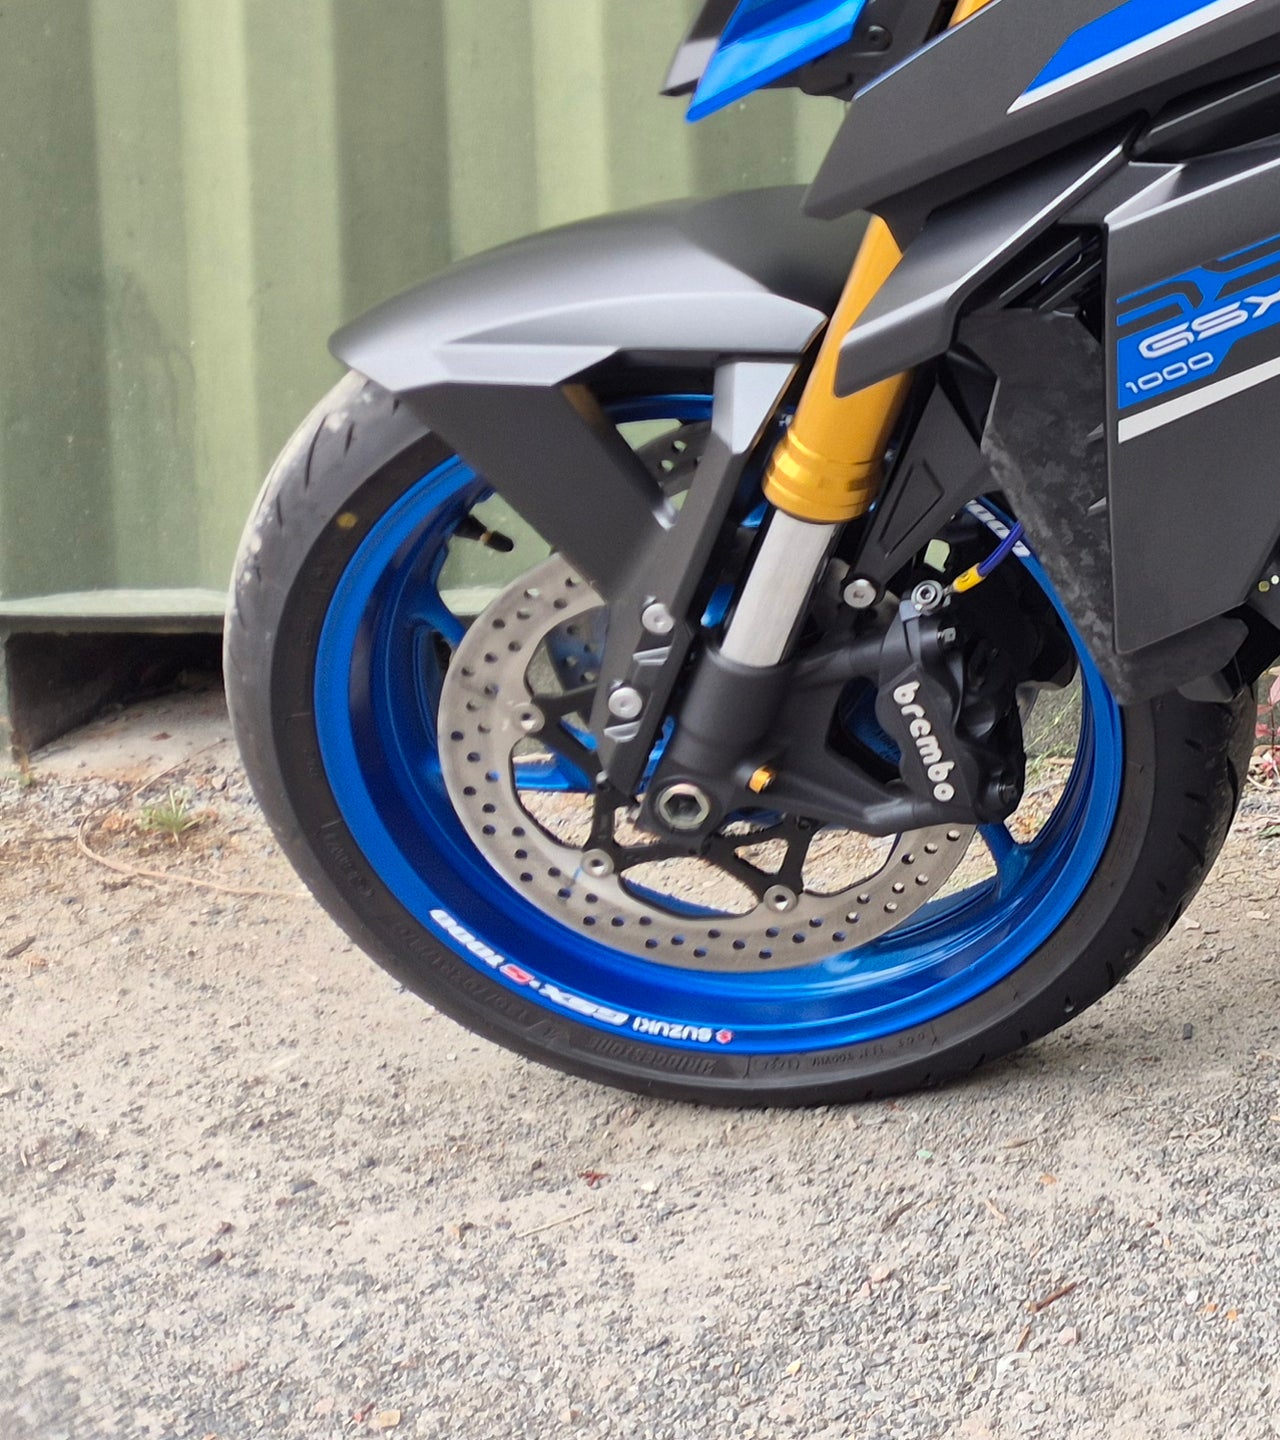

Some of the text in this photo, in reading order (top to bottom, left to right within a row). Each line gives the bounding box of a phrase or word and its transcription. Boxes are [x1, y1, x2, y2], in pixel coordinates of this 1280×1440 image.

[1125, 351, 1214, 394] 1000
[893, 681, 956, 802] brembo
[632, 1016, 713, 1043] SUZUKI
